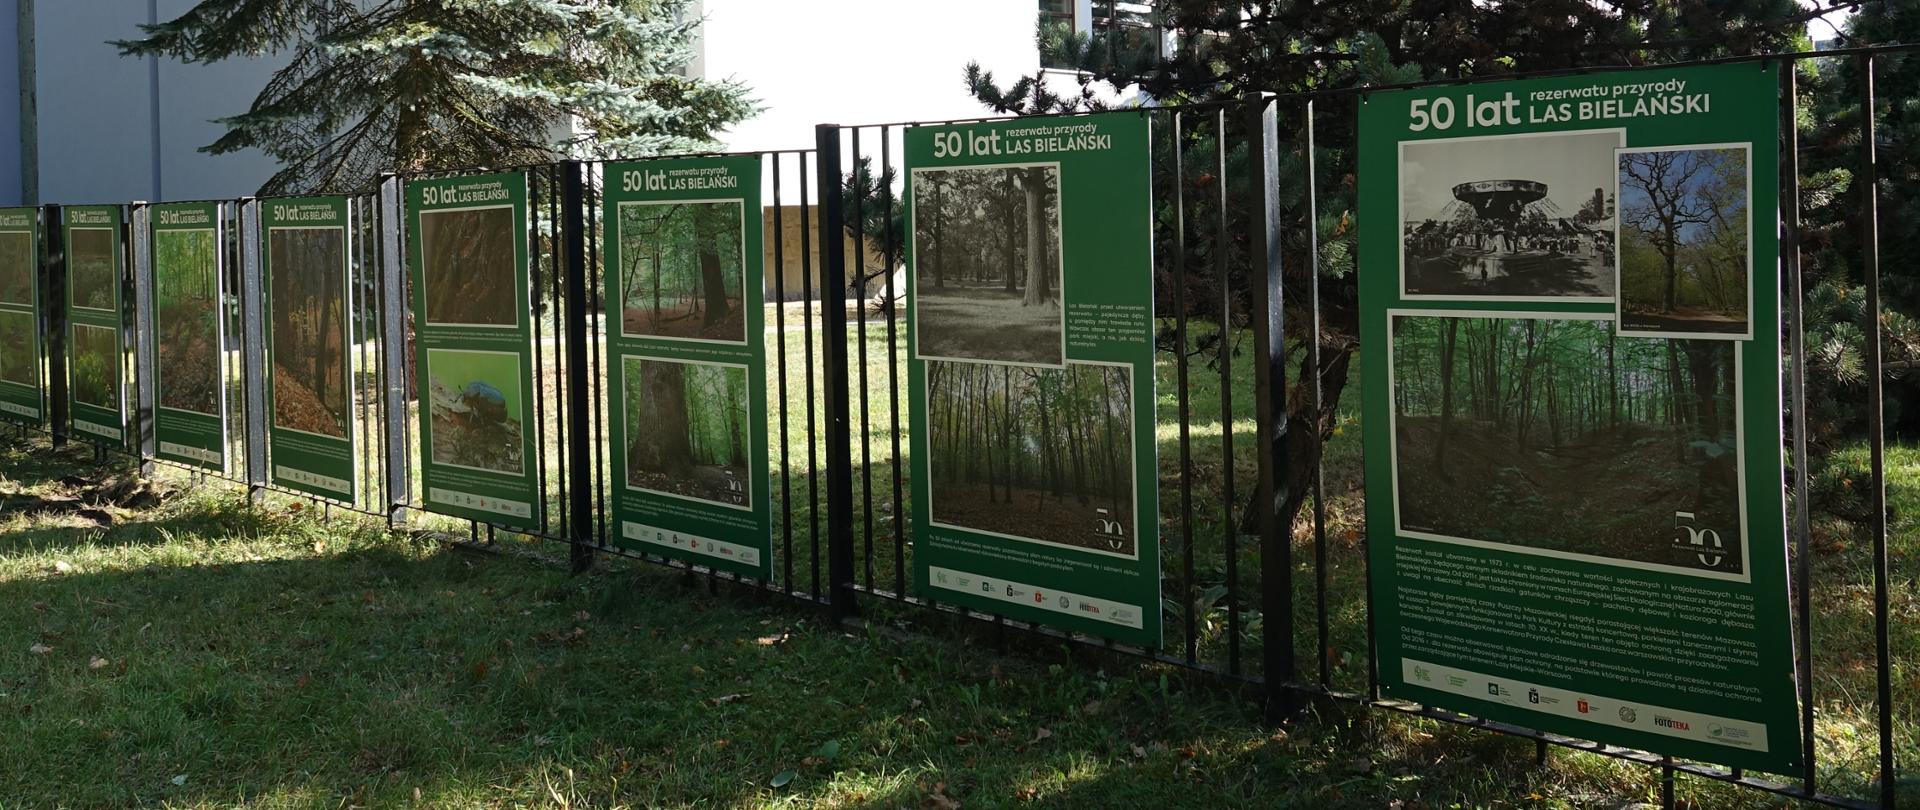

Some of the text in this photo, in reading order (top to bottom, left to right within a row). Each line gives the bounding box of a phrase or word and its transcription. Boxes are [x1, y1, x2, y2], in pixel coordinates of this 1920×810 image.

[1530, 78, 1685, 101] rezerwatu przyrody
[1409, 92, 1521, 131] 50 lat
[1529, 92, 1710, 123] LAS BIELAŃSKI
[1006, 123, 1097, 137] rezerwatu przyrody
[934, 129, 1001, 158] 50 lat
[1006, 134, 1111, 154] LAS BIELAŃSKI
[623, 170, 666, 191] 50 lat
[700, 166, 728, 175] przyrody
[670, 175, 737, 190] LAS BIELAŃSKI
[423, 186, 456, 205] 50 lat
[459, 189, 508, 202] LAS BIELAŃSKI
[160, 210, 169, 224] 50
[274, 205, 298, 220] 50 lat
[1445, 552, 1477, 563] utworzony
[1539, 566, 1579, 577] zachowania
[1583, 572, 1612, 581] wartości
[1616, 576, 1660, 589] społecznych
[1670, 584, 1730, 599] krajobrazowych
[1735, 592, 1753, 600] Lasu
[1518, 588, 1551, 600] gatunków
[1602, 601, 1635, 613] pachnicy
[1679, 612, 1717, 625] kozioroga
[1720, 618, 1755, 630] dębosza.
[1612, 585, 1659, 598] zachowanym
[1672, 593, 1706, 603] obszarze
[1708, 598, 1754, 611] aglomeracji
[1674, 602, 1701, 612] Natura
[1701, 606, 1723, 616] 2000,
[1723, 609, 1755, 621] głównie
[1538, 617, 1561, 627] Kultury
[1641, 633, 1680, 646] parkietami
[1732, 647, 1758, 658] słynną
[1596, 618, 1641, 631] porastającej
[1681, 630, 1712, 641] terenów
[1715, 635, 1758, 647] Mazowsza.
[1615, 638, 1639, 649] objęto
[1641, 642, 1672, 654] ochroną
[1674, 647, 1695, 657] dzięki
[1697, 651, 1759, 667] zaangażowaniu
[1676, 656, 1730, 672] przyrodników.
[1601, 670, 1628, 682] którego
[1630, 675, 1676, 690] prowadzone
[1724, 691, 1763, 703] ochronne
[1646, 669, 1672, 680] powrót
[1674, 674, 1711, 687] procesów
[1713, 680, 1762, 695] naturalnych.
[1654, 716, 1690, 731] FOTOTEKA
